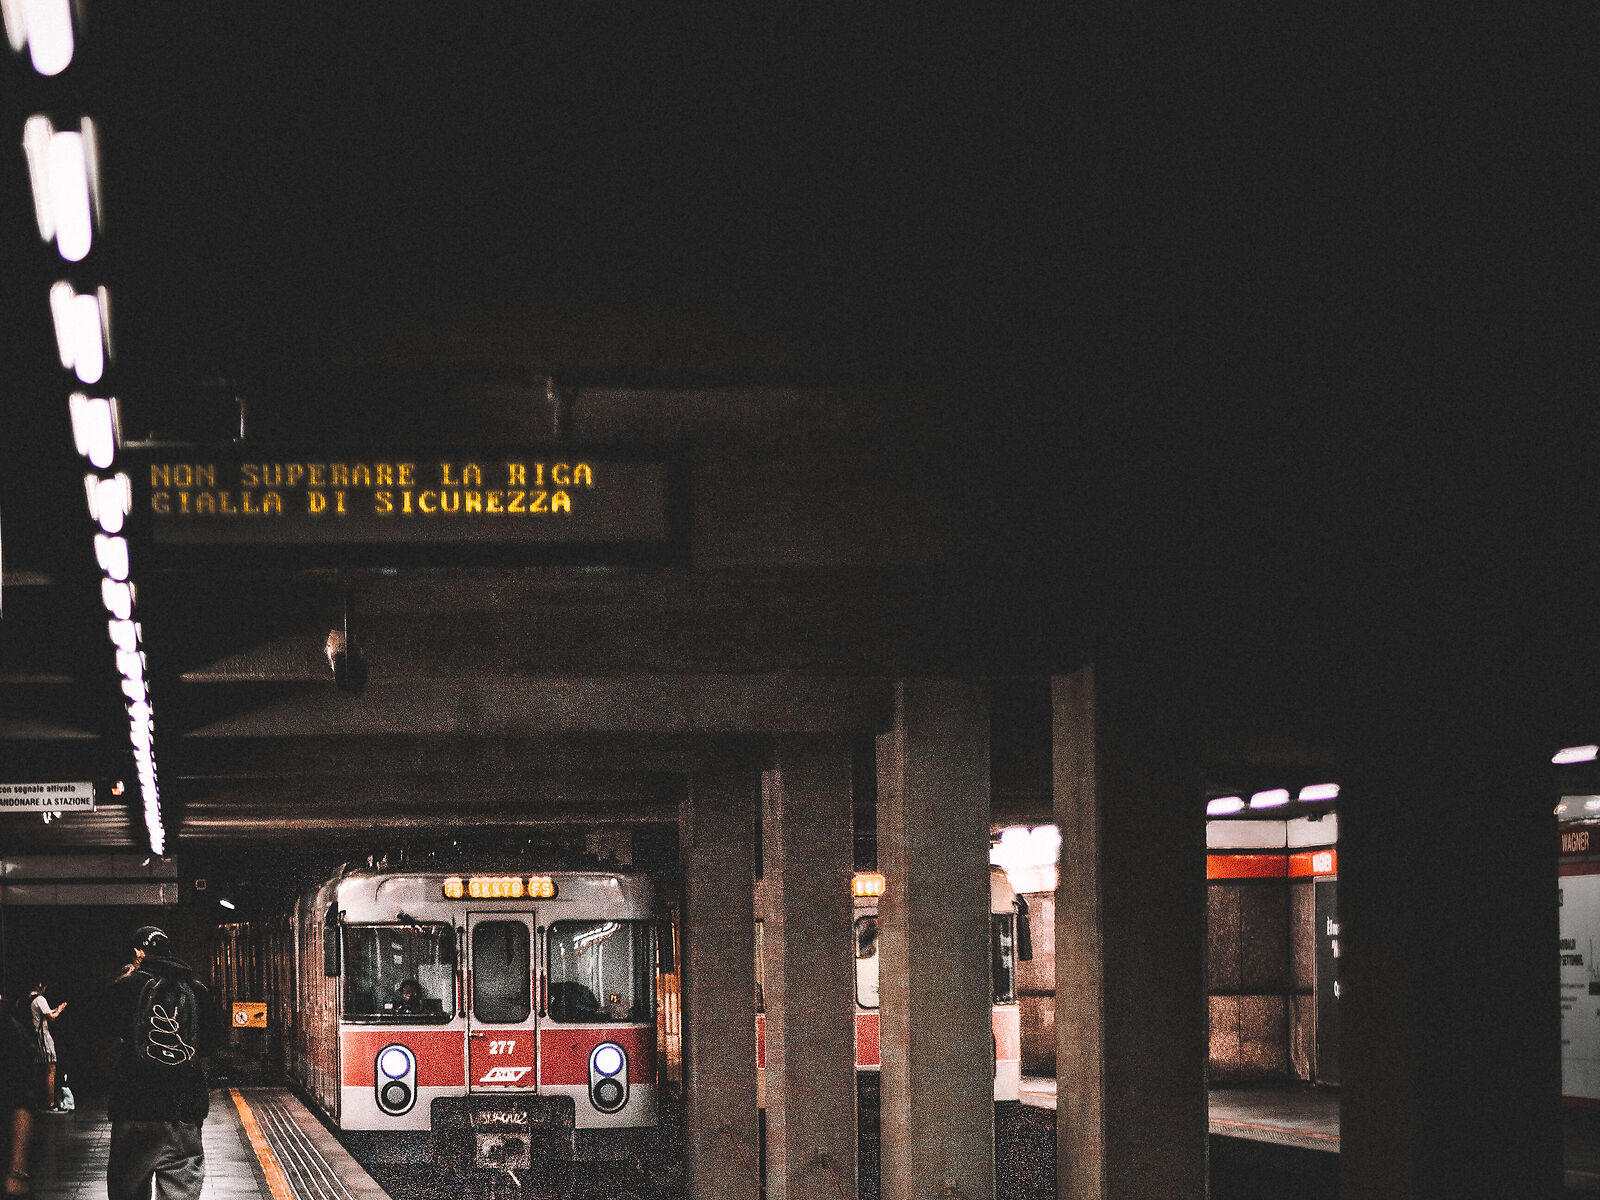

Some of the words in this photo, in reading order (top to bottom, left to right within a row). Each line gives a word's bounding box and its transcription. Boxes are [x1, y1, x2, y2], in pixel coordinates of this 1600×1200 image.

[151, 463, 216, 487] NON
[240, 463, 416, 487] SUPERARE
[441, 463, 483, 487] LA
[508, 462, 594, 486] RIGA
[151, 491, 284, 514] GIALLA
[308, 491, 347, 514] DI
[374, 490, 572, 514] SICUREZZA
[14, 785, 44, 795] segnale
[46, 784, 76, 793] attivato
[43, 798, 52, 806] LA
[54, 797, 91, 806] STAZIONE
[1561, 831, 1590, 852] WAGNER
[489, 1040, 516, 1055] 277
